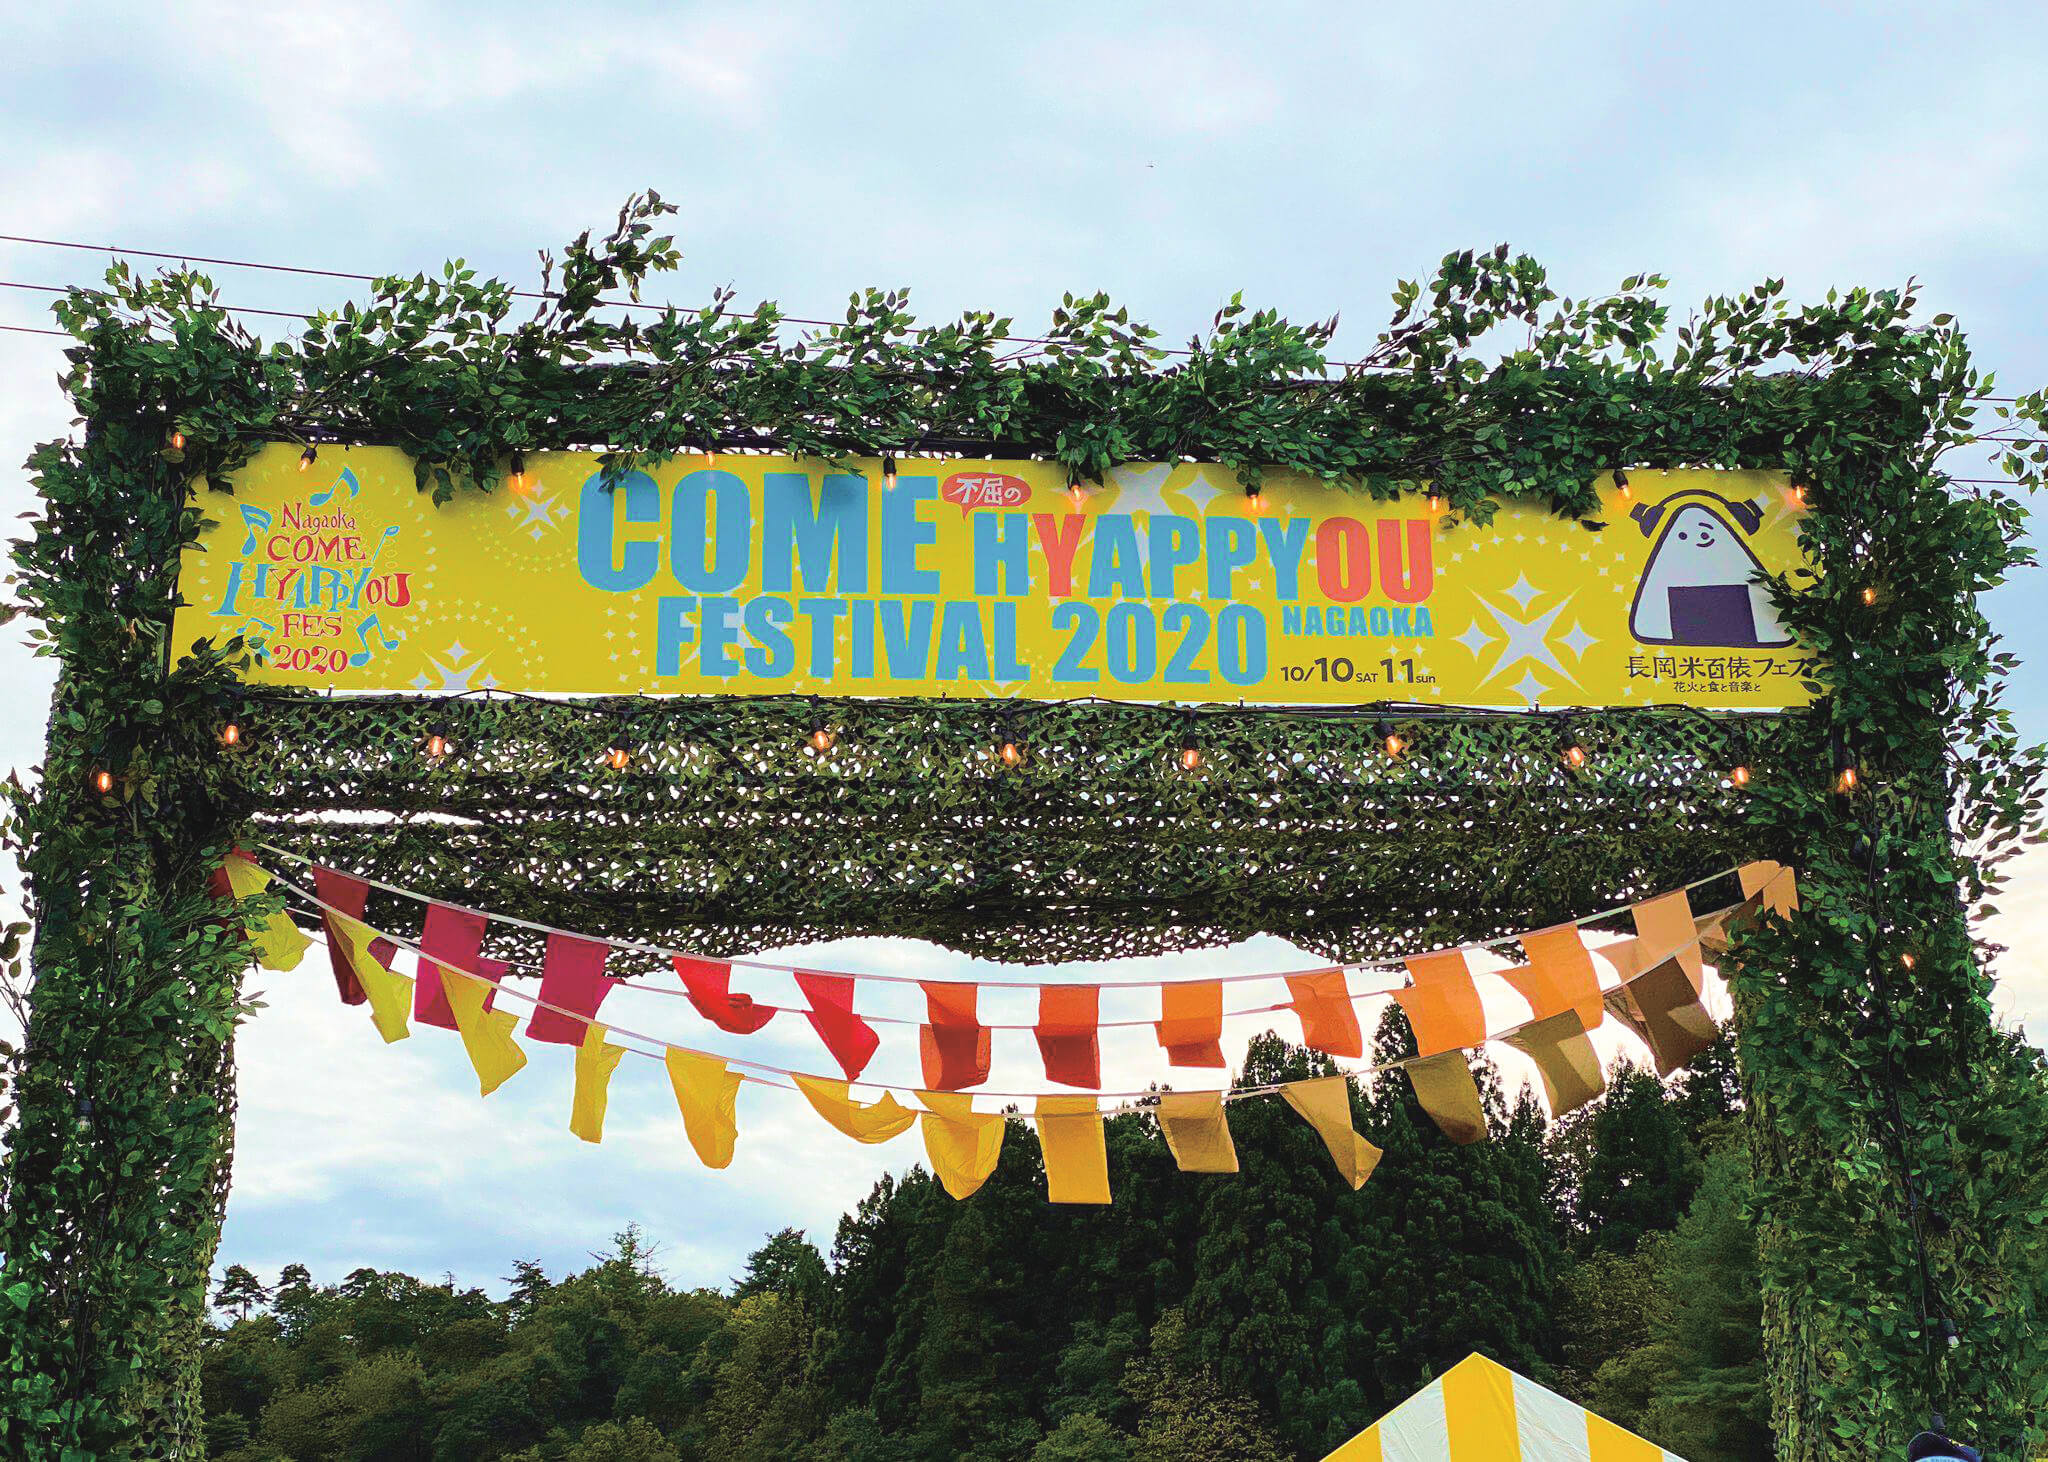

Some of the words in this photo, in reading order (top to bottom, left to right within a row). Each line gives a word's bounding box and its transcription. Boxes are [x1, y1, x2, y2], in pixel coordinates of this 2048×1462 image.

[947, 477, 1022, 505] 不屈の
[281, 502, 356, 535] Nagaoka
[578, 470, 940, 594] COME
[266, 535, 366, 563] COME
[973, 512, 1434, 603] HYAPPYOU
[282, 614, 342, 638] FES
[1281, 605, 1435, 637] NAGAOKA
[655, 596, 1031, 681] FESTIVAL
[1051, 602, 1268, 686] 2020
[273, 644, 348, 675] 2020
[1673, 681, 1761, 693] 花火と食と音楽と
